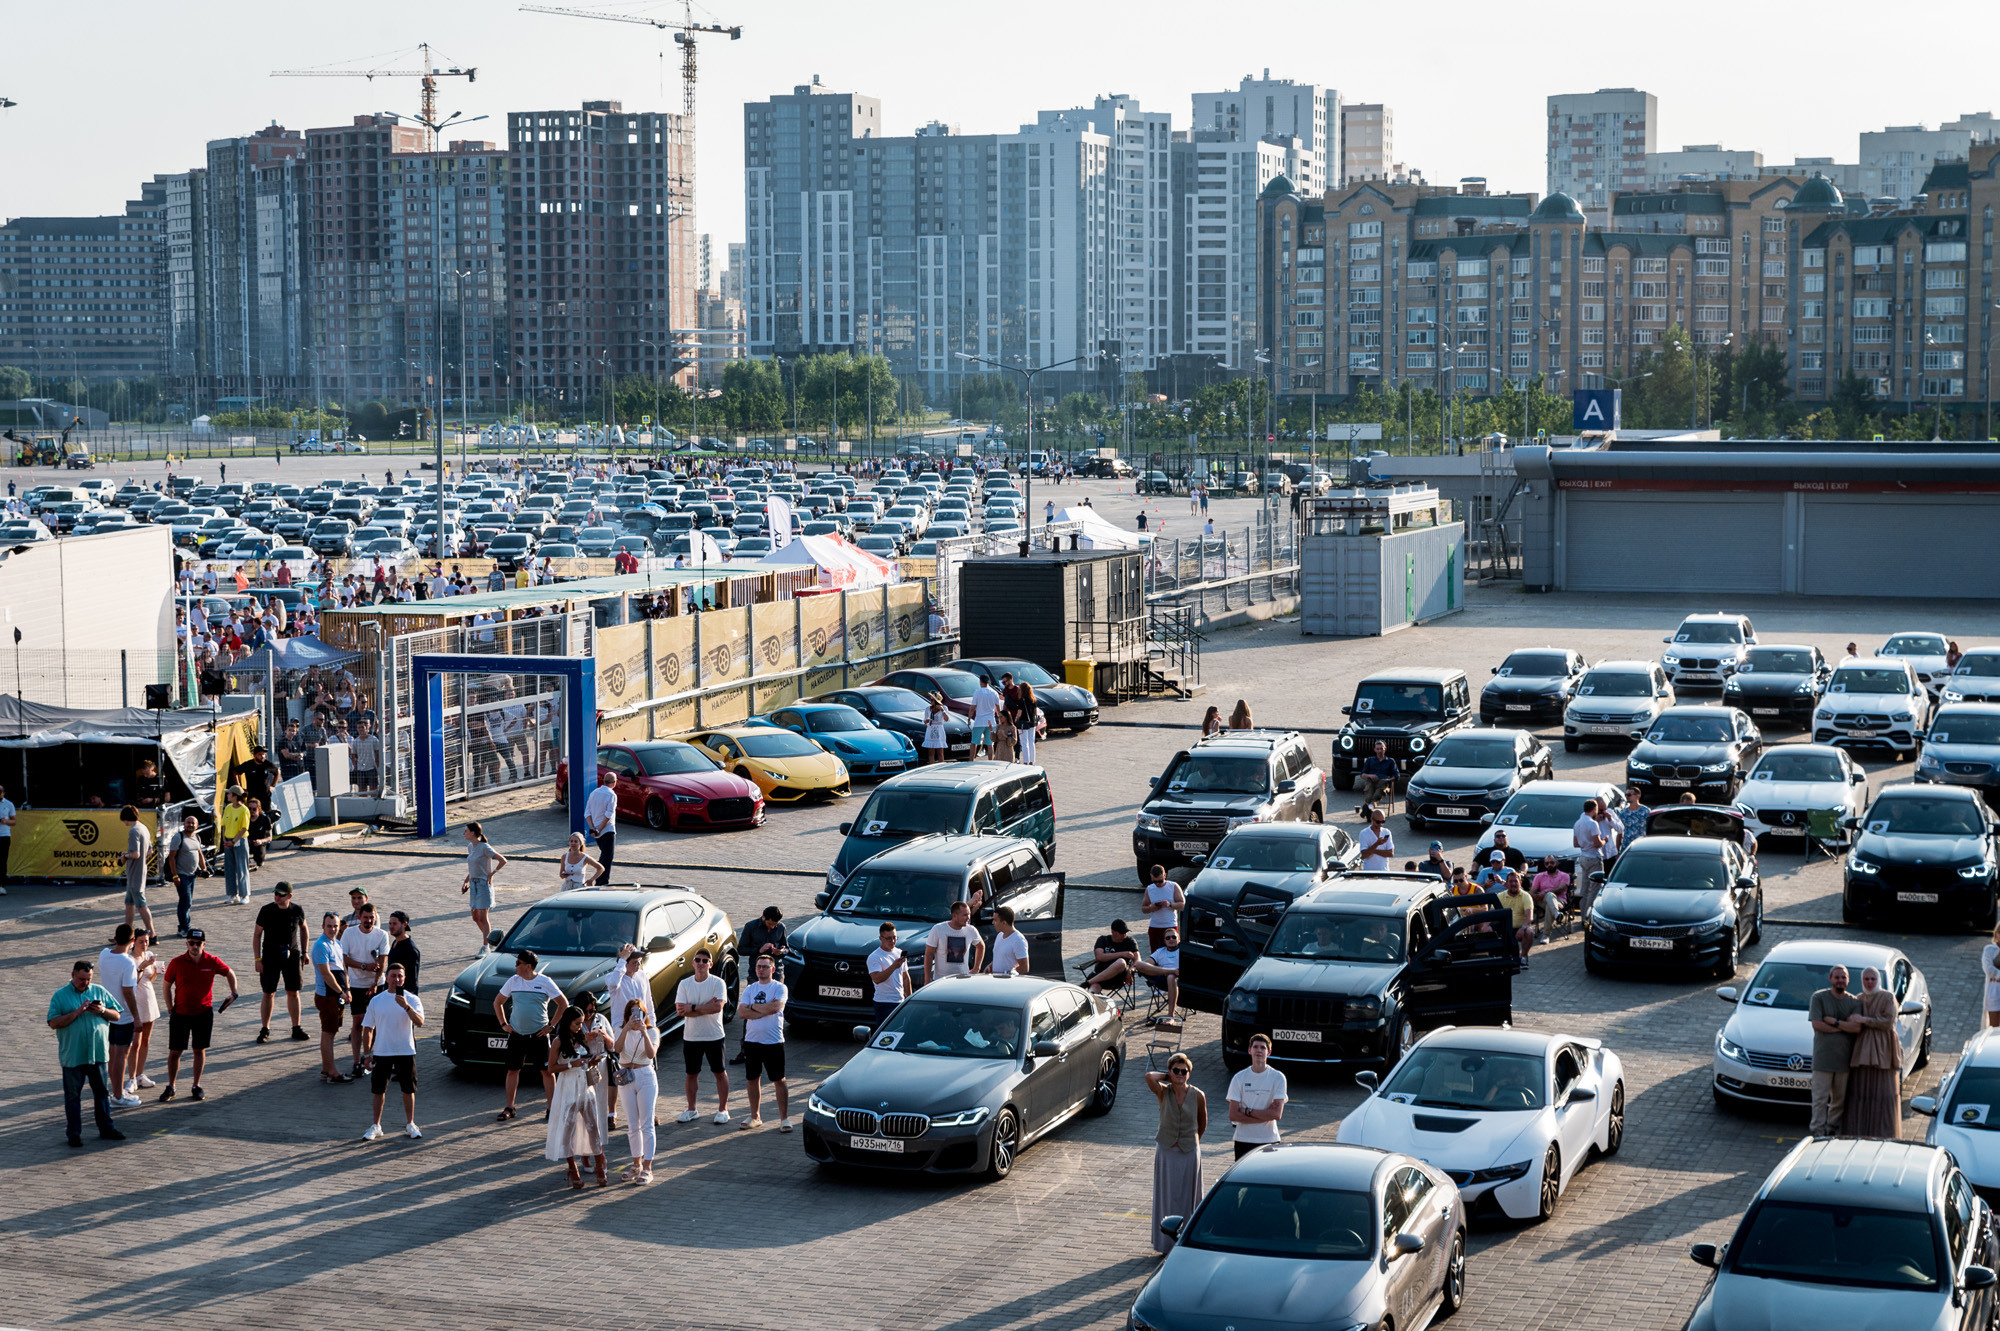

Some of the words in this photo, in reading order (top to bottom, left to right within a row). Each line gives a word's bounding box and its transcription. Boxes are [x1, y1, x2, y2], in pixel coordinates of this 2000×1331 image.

[1583, 399, 1604, 420] A
[1559, 480, 1589, 488] ВЫХОД
[1594, 480, 1613, 488] EXIT
[1793, 482, 1825, 490] ВЫХОД
[1831, 482, 1849, 490] EXIT
[54, 850, 122, 858] БИЗНЕС-ФОРУМ
[61, 860, 73, 868] НА
[74, 860, 115, 868] КОЛЕСАХ
[1632, 939, 1662, 947] К984РУ
[821, 986, 851, 997] Р777ОВ
[1275, 1030, 1307, 1040] Р007СО
[1771, 1076, 1808, 1087] О388ОО
[853, 1138, 887, 1150] Н935НМ
[888, 1140, 902, 1149] 716
